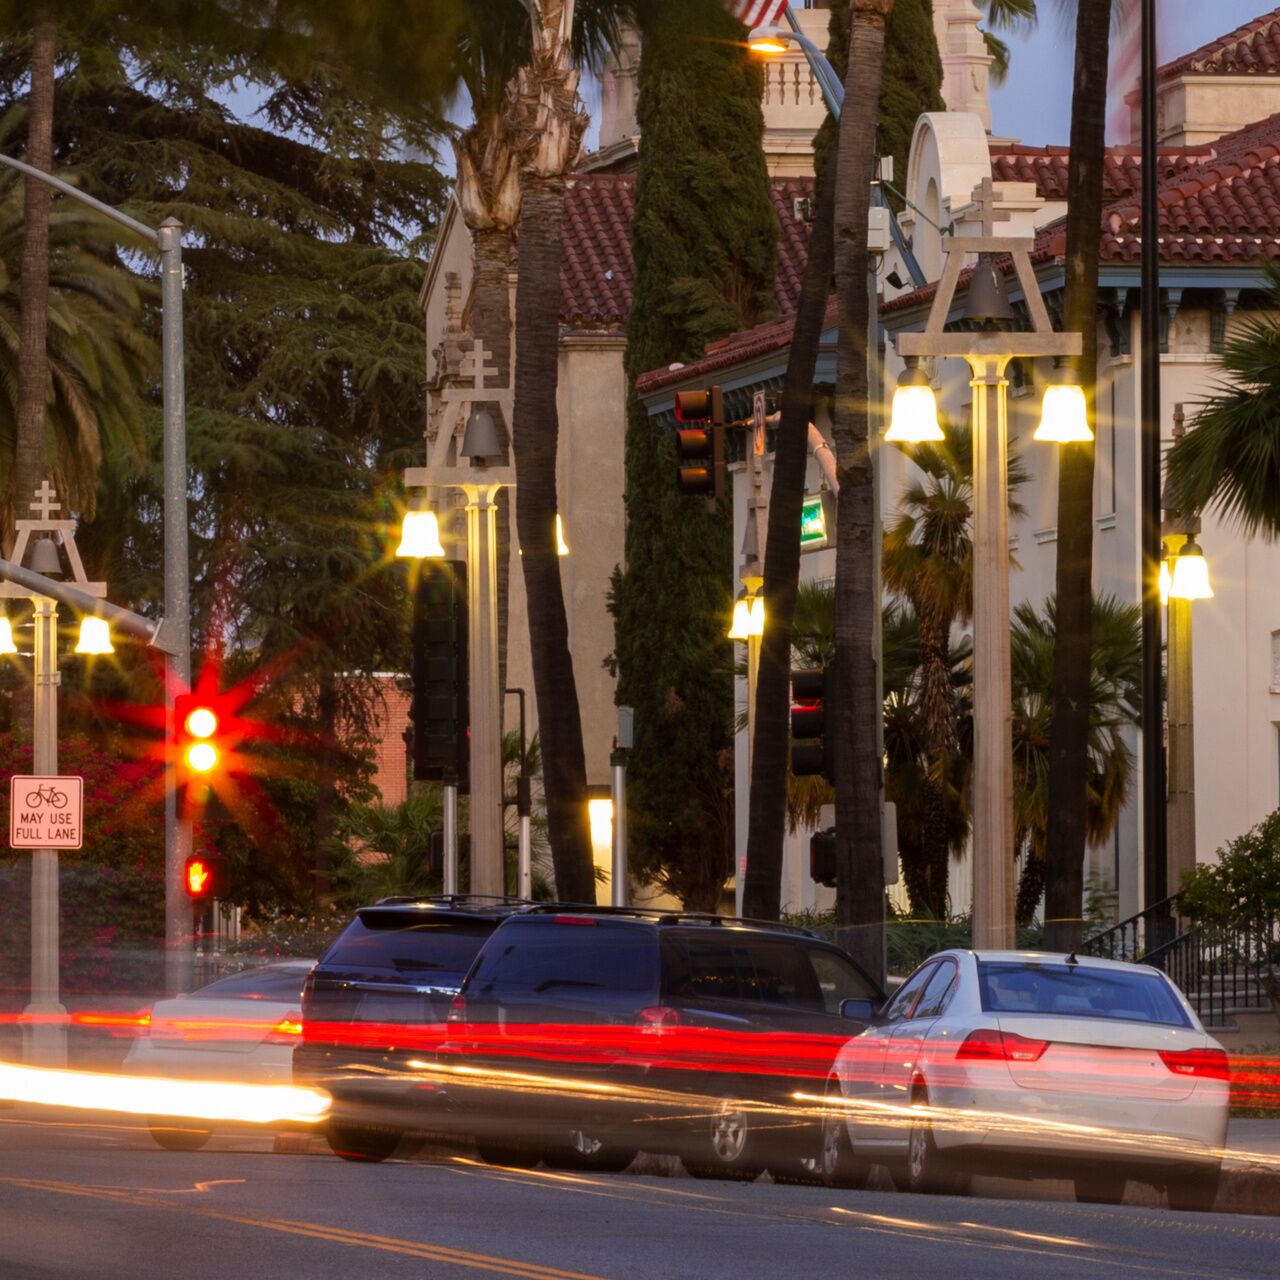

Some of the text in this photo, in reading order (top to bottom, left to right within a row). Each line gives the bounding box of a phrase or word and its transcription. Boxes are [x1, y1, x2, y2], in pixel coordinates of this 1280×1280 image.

[20, 812, 72, 824] MAY USE
[16, 827, 76, 839] FULL LANE
